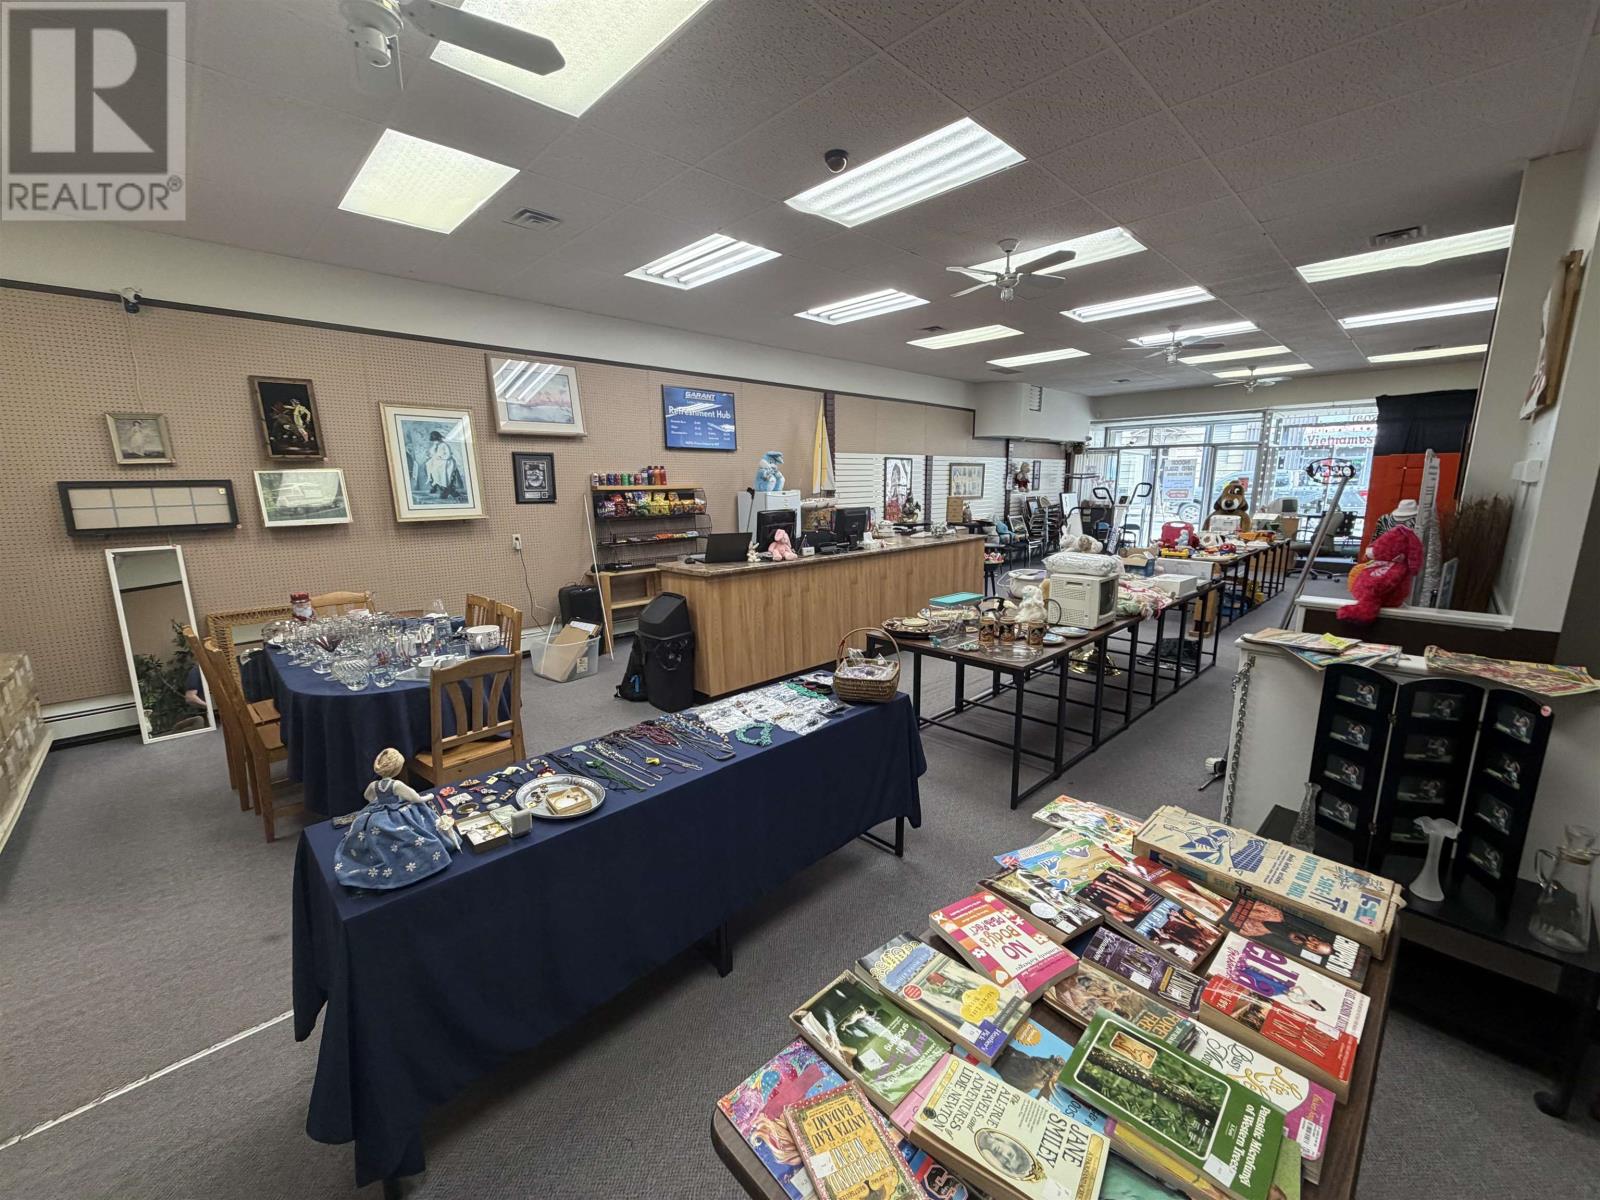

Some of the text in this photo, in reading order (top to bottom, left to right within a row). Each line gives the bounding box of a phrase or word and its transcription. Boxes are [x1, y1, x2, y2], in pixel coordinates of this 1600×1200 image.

[716, 410, 731, 419] Hub
[1307, 434, 1375, 446] Vietnames
[1001, 939, 1032, 960] NO
[1093, 933, 1115, 961] Cinnamon
[978, 1028, 990, 1041] Pick
[979, 1027, 1001, 1051] Heather's
[1226, 1042, 1253, 1072] Busy
[952, 1065, 973, 1091] LIDIE
[811, 1103, 854, 1130] BADAMI
[930, 1089, 962, 1132] NEWTON
[949, 1071, 987, 1132] ADVENTURES
[966, 1079, 999, 1132] TRAVELS and
[985, 1086, 1013, 1128] ALL-TRUE
[810, 1111, 868, 1148] ANITA RAU
[943, 1128, 954, 1140] of
[1035, 1111, 1067, 1168] SMILEY
[1060, 1122, 1090, 1168] JANE
[1227, 1103, 1257, 1172] of Western Trees
[1237, 1104, 1271, 1187] Parasitic Microfungi
[829, 1135, 869, 1170] MEM
[826, 1148, 891, 1194] TAMARIND
